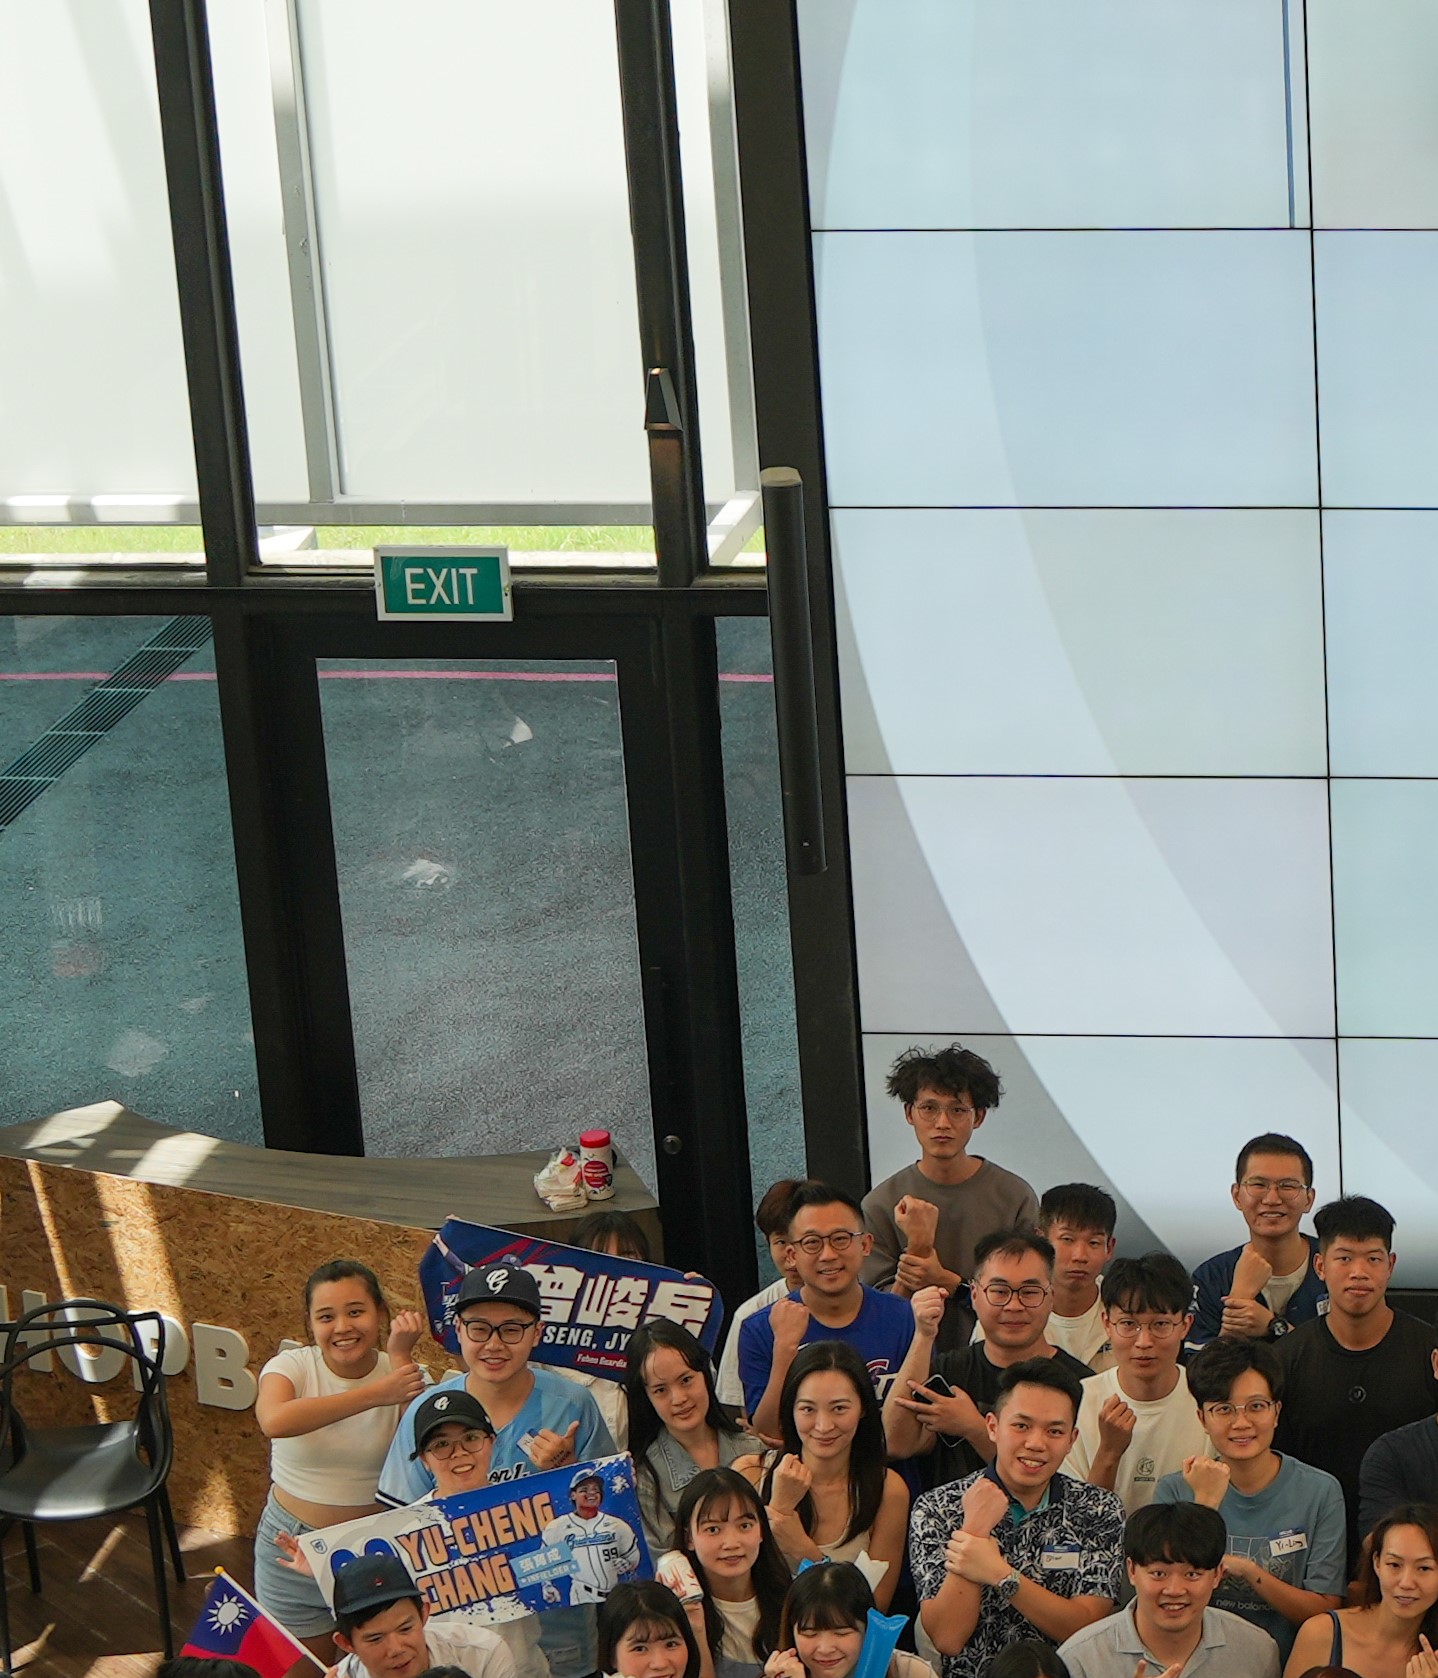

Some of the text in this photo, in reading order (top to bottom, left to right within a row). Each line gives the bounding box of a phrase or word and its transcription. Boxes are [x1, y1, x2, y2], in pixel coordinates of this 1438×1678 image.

[404, 567, 478, 605] EXIT
[543, 1326, 599, 1350] SENG,
[395, 1492, 555, 1572] YU-CHENG
[602, 1547, 619, 1562] 99
[417, 1554, 516, 1615] CHANG
